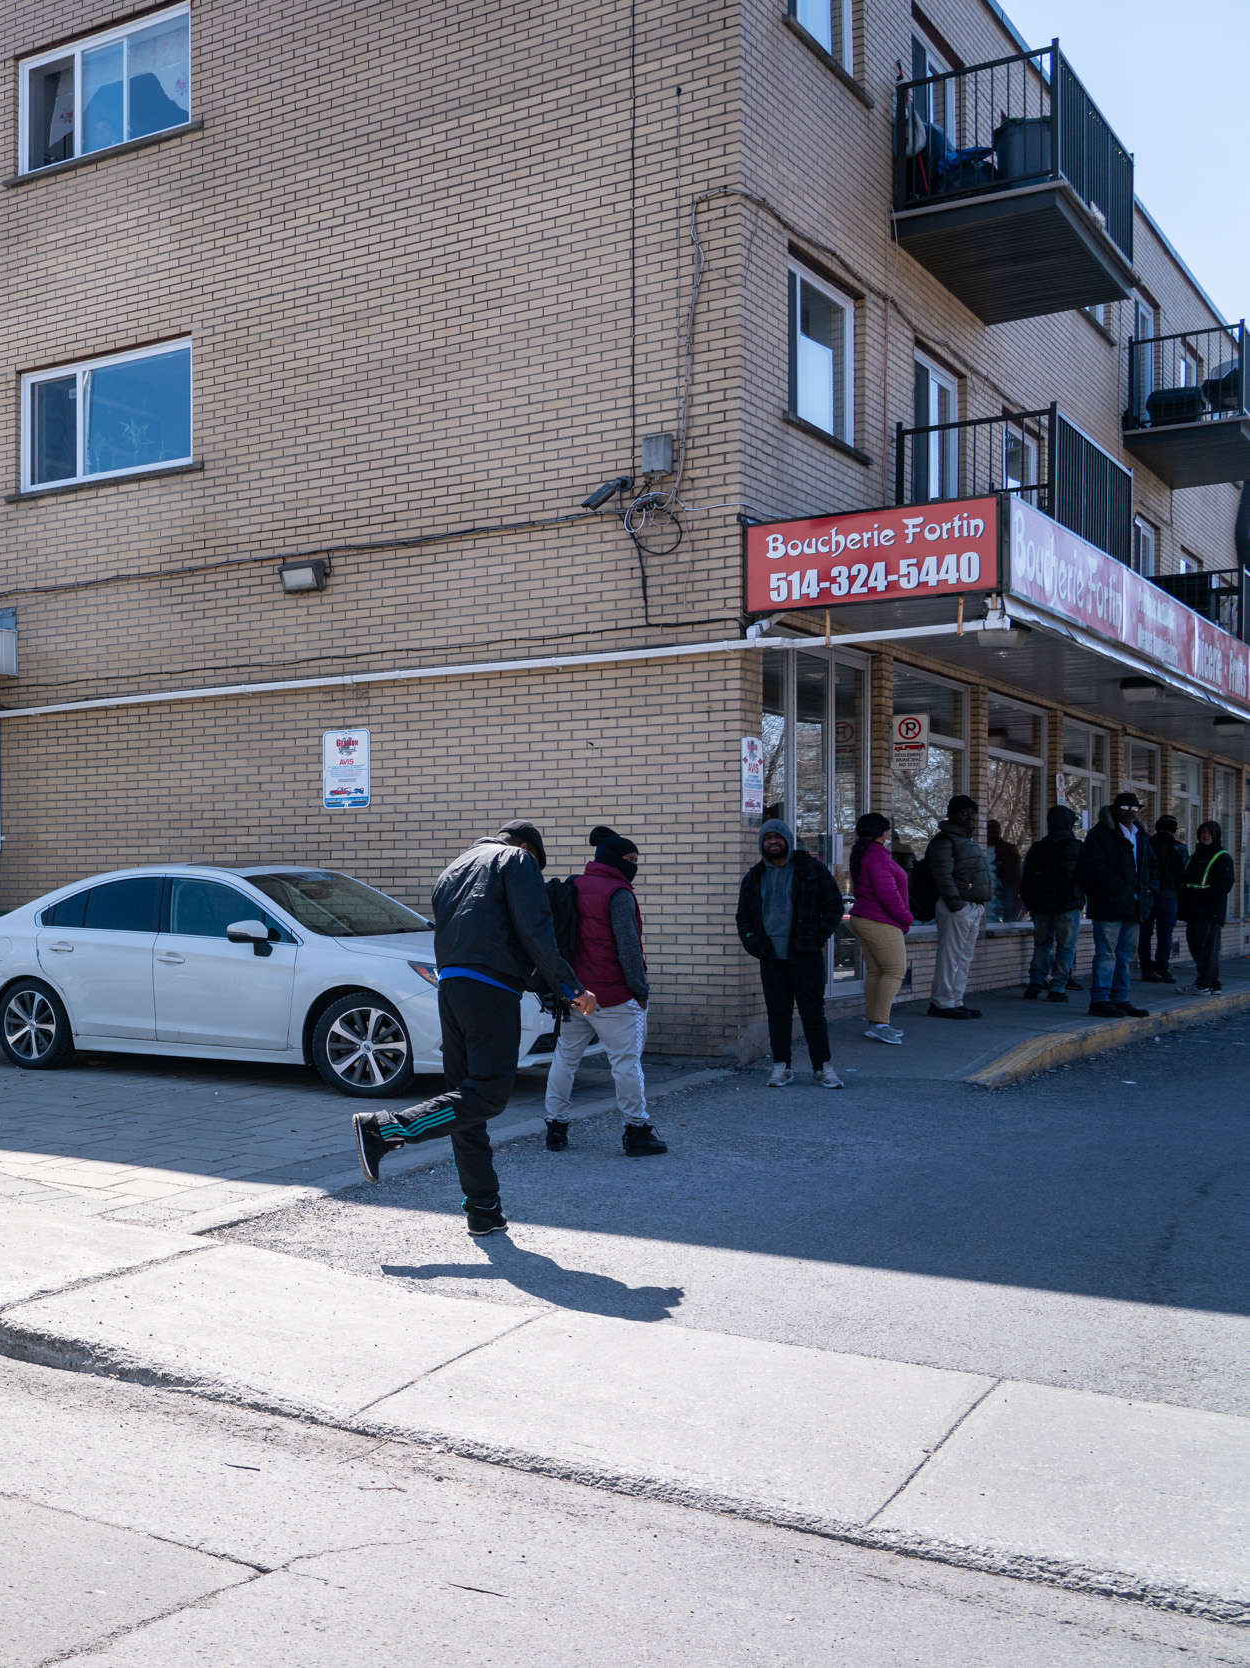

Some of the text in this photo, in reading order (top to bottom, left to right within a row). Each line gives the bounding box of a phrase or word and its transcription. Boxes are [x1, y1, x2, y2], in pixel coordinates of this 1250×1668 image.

[765, 512, 986, 559] Boucherie Fortin
[769, 551, 981, 603] 514-324-5440
[339, 758, 354, 766] AVIS
